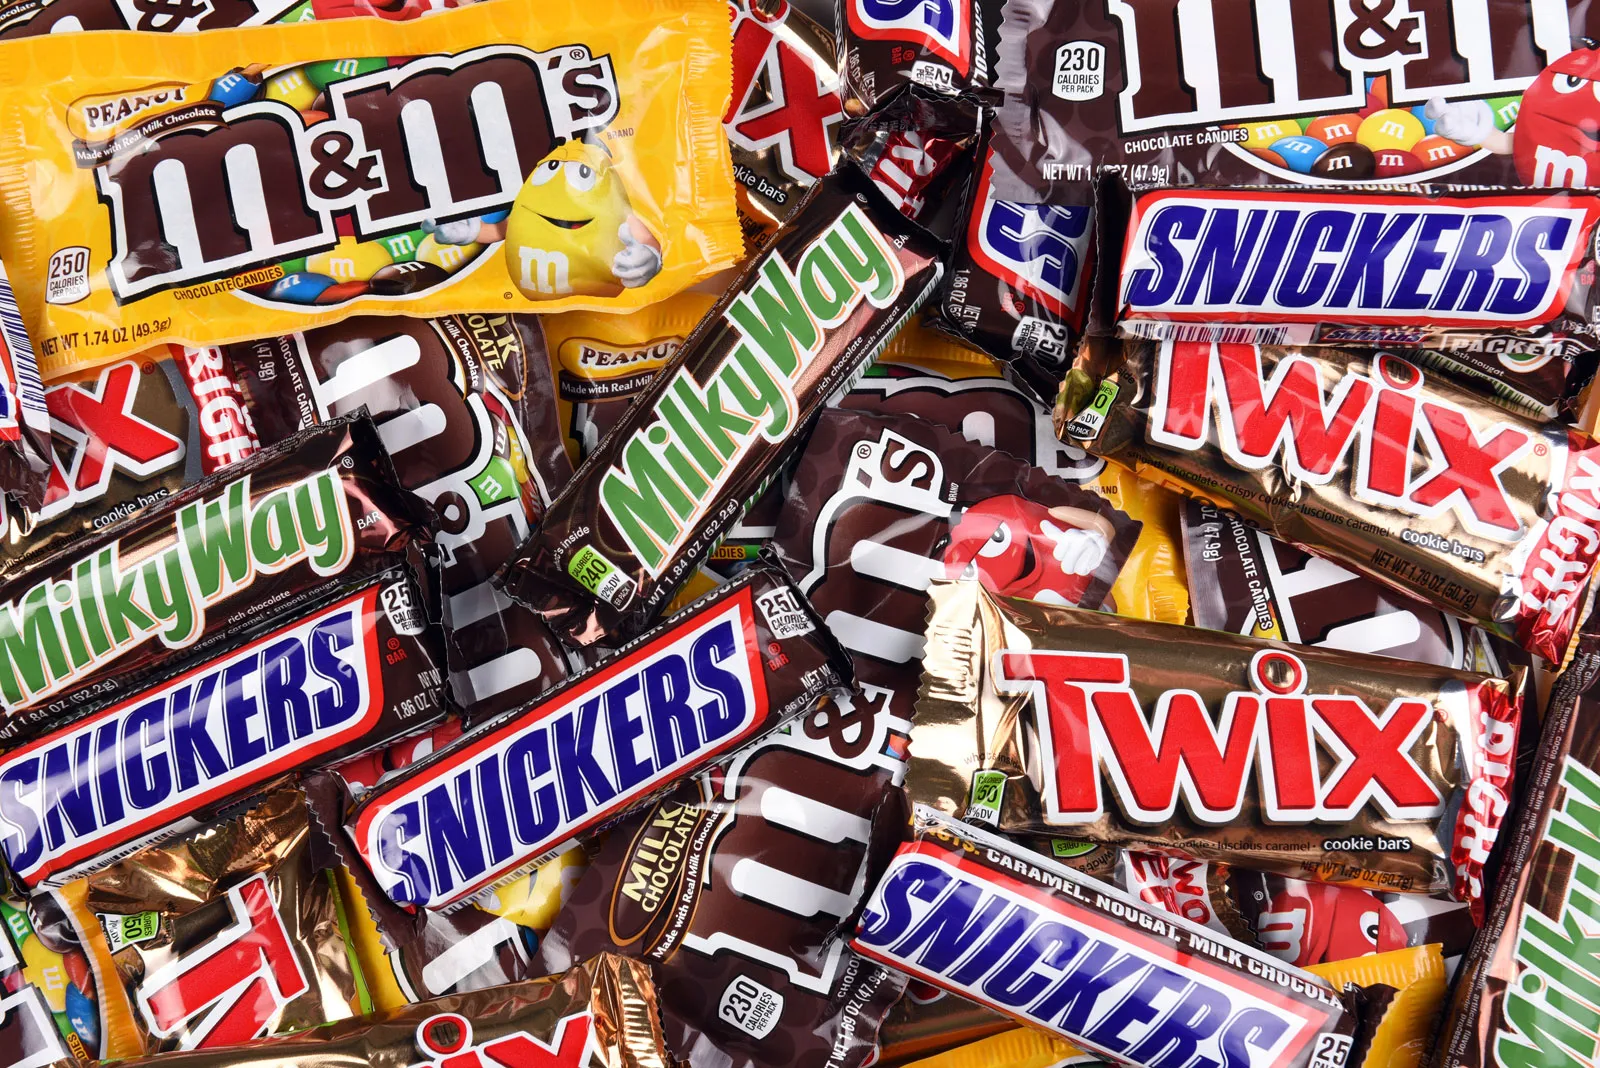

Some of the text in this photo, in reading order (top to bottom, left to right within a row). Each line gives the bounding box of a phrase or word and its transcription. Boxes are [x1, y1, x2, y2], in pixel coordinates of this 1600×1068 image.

[1060, 48, 1099, 72] 230
[1057, 73, 1100, 86] CALORIES
[1061, 84, 1094, 93] PER PACK
[76, 107, 217, 162] Made with Real Milk Chocolate
[606, 127, 636, 141] BRAND
[1125, 128, 1249, 154] CHOCOLATE CANDIES
[1043, 164, 1065, 181] NET
[1066, 164, 1084, 181] WT
[1131, 164, 1170, 184] (47.9g)
[757, 179, 786, 203] bars
[51, 252, 86, 279] 250
[1123, 204, 1573, 314] SNICKERS
[49, 275, 86, 292] CALORIES
[64, 284, 83, 296] PACK
[173, 266, 284, 301] CHOCOLATE CANDIES
[41, 317, 172, 358] NET WT 1.74 OZ (49.3g)
[851, 306, 901, 366] smooth nougat
[253, 342, 277, 382] (47.9g)
[457, 338, 480, 387] Chocolate
[816, 336, 864, 395] rich chocolate
[1471, 356, 1505, 377] nougat
[277, 336, 314, 430] HOCOLATE CANDI
[561, 379, 633, 395] Made with Real
[1075, 426, 1090, 436] PACK
[949, 482, 959, 502] BRAND
[93, 487, 170, 530] cookie bars
[357, 511, 382, 531] BAR
[702, 498, 739, 542] (52.2g)
[1224, 483, 1257, 500] crispy
[1258, 493, 1295, 511] cookie
[1299, 503, 1344, 527] luscious
[1346, 517, 1391, 538] caramel
[562, 525, 591, 549] inside
[688, 541, 704, 560] OZ
[709, 546, 745, 559] NDIES
[1203, 522, 1223, 562] (47.9g)
[1402, 528, 1485, 563] cookie bars
[571, 550, 594, 578] CALORIES
[580, 558, 607, 590] 240
[1371, 548, 1480, 612] NET WT 1.79 OZ (50.7g)
[619, 584, 631, 600] PACK
[648, 557, 689, 607] WT 1.84
[193, 630, 227, 653] creamy
[227, 614, 266, 636] caramel
[273, 593, 308, 615] smooth
[308, 578, 342, 597] nougat
[227, 589, 291, 625] rich chocolate
[1248, 580, 1274, 631] CANDIES
[386, 649, 408, 665] BAR
[768, 653, 789, 671] BAR
[19, 707, 49, 728] 1.84
[50, 699, 69, 715] OZ
[70, 678, 119, 705] (52.2g)
[392, 692, 431, 721] 1.86 OZ
[777, 693, 812, 717] 1.86 OZ
[0, 610, 361, 873] SNICKERS
[991, 648, 1446, 827] Twix
[1550, 736, 1562, 760] cocoa
[377, 619, 747, 907] SNICKERS
[621, 799, 685, 902] MILK
[641, 802, 698, 913] CHOCOLATE
[1217, 840, 1264, 852] luscious
[1264, 841, 1311, 852] caramel
[1324, 838, 1374, 852] cookie
[1377, 837, 1411, 851] bars
[653, 803, 725, 959] Made with Real Milk Chocolate
[1301, 861, 1414, 892] NET WT 1.79 OZ (50.7g)
[987, 850, 1090, 904] CARAMEL.
[1096, 893, 1182, 942] NOUGAT.
[1190, 934, 1243, 969] MILK
[858, 860, 1290, 1068] SNICKERS
[723, 980, 760, 1024] 230
[745, 991, 773, 1032] CALORIES
[757, 999, 778, 1031] PER PACK
[845, 1000, 864, 1017] OZ
[837, 1015, 856, 1042] 1.69
